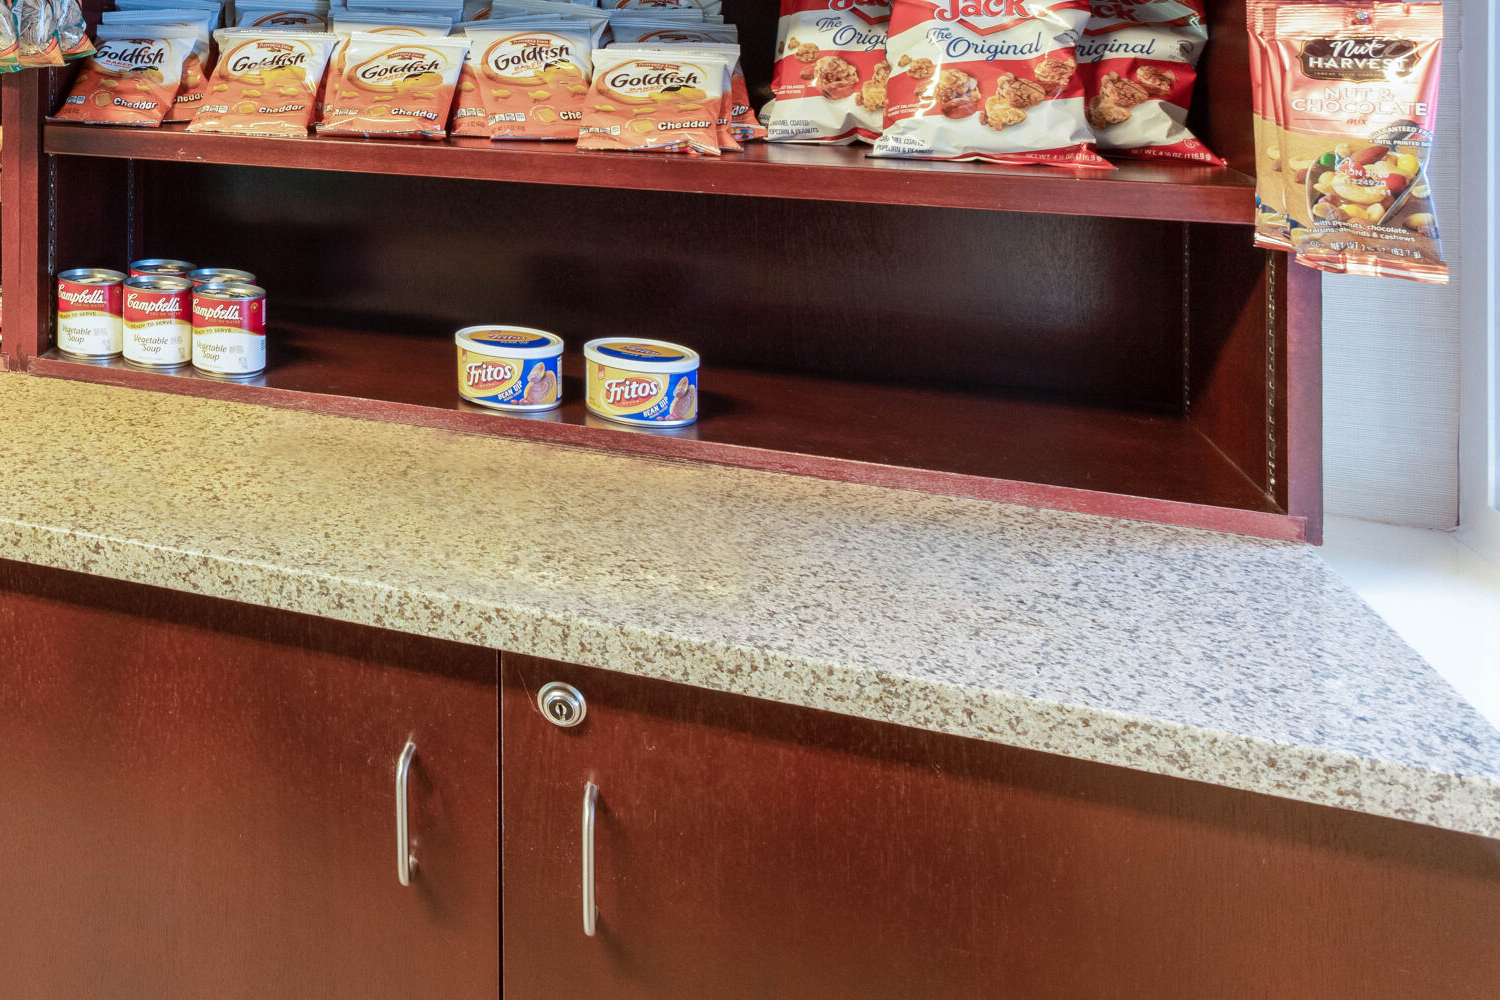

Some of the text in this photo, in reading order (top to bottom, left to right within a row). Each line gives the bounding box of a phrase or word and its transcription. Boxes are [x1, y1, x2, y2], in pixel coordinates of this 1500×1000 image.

[816, 17, 842, 32] The
[926, 27, 951, 44] The
[946, 31, 1042, 62] Original
[1330, 40, 1385, 58] Nut
[94, 45, 164, 64] Goldfish
[494, 44, 570, 70] Goldfish
[232, 53, 305, 72] Goldfish
[362, 59, 439, 80] Goldfish
[610, 72, 700, 88] Goldfish
[1324, 87, 1372, 100] NUT
[114, 97, 157, 110] Cheddar
[258, 104, 304, 113] Cheddar
[1292, 99, 1428, 116] CHOCOLATE
[390, 107, 438, 120] Cheddar
[657, 120, 711, 130] Cheddar
[1367, 224, 1409, 235] chocolate,
[1380, 234, 1416, 243] cashews
[58, 283, 104, 304] Campbell's
[127, 293, 180, 314] Campbell's
[193, 298, 241, 320] Campbell's
[62, 326, 92, 335] Vegetable
[68, 335, 84, 344] Soup
[134, 334, 169, 345] Vegetable
[142, 344, 162, 353] Soup
[196, 343, 227, 353] Vegetable
[203, 351, 220, 361] Soup
[466, 363, 512, 386] Fritos
[513, 380, 523, 393] DIP
[605, 378, 659, 404] Fritos
[659, 396, 668, 408] DIP
